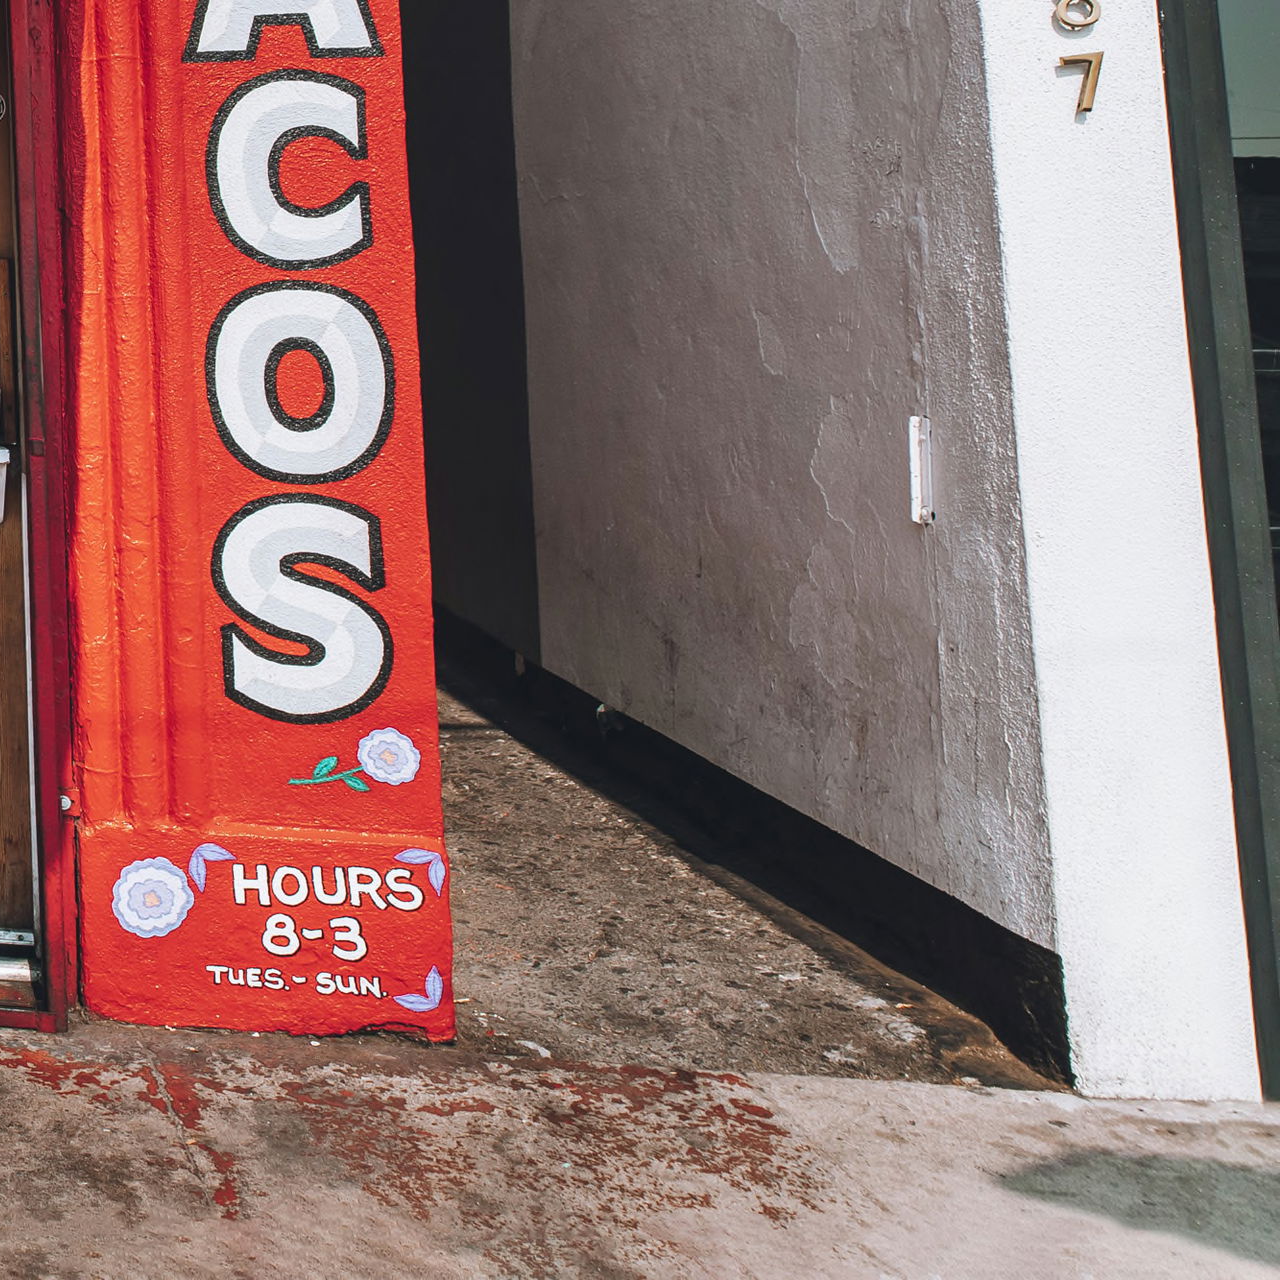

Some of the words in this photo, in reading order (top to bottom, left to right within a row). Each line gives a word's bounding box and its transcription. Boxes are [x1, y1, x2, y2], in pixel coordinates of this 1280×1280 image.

[233, 863, 425, 911] HOURS
[261, 913, 368, 962] 8-3
[315, 972, 388, 998] SUN.
